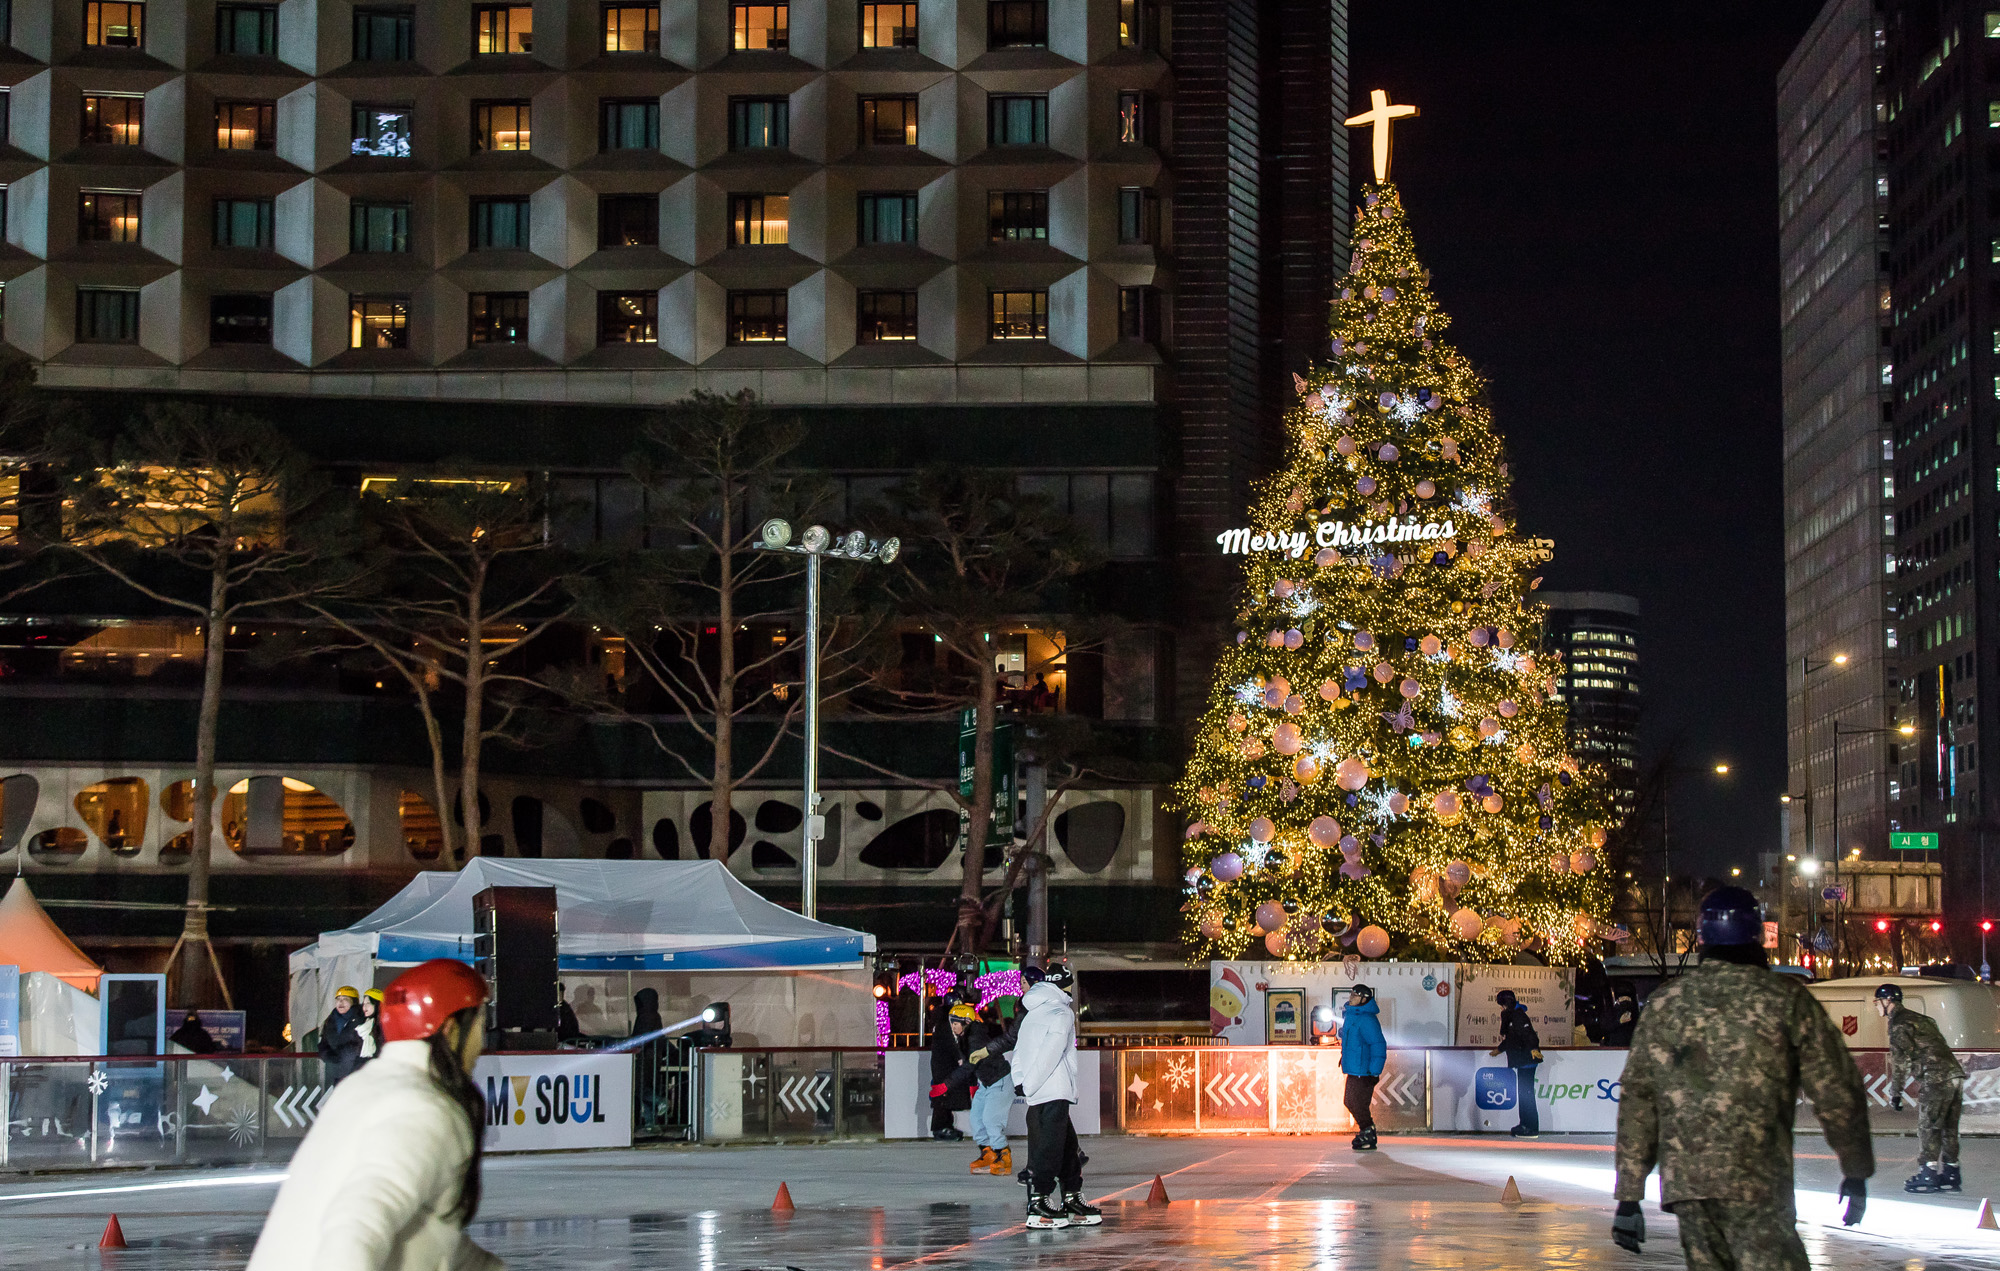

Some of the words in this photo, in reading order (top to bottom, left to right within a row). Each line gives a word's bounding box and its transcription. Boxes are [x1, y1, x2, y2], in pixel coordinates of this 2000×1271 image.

[1216, 527, 1310, 559] Merry
[1316, 516, 1458, 547] Christmas
[535, 1074, 605, 1125] SOUL
[1534, 1078, 1594, 1105] uper
[1597, 1078, 1621, 1103] SO
